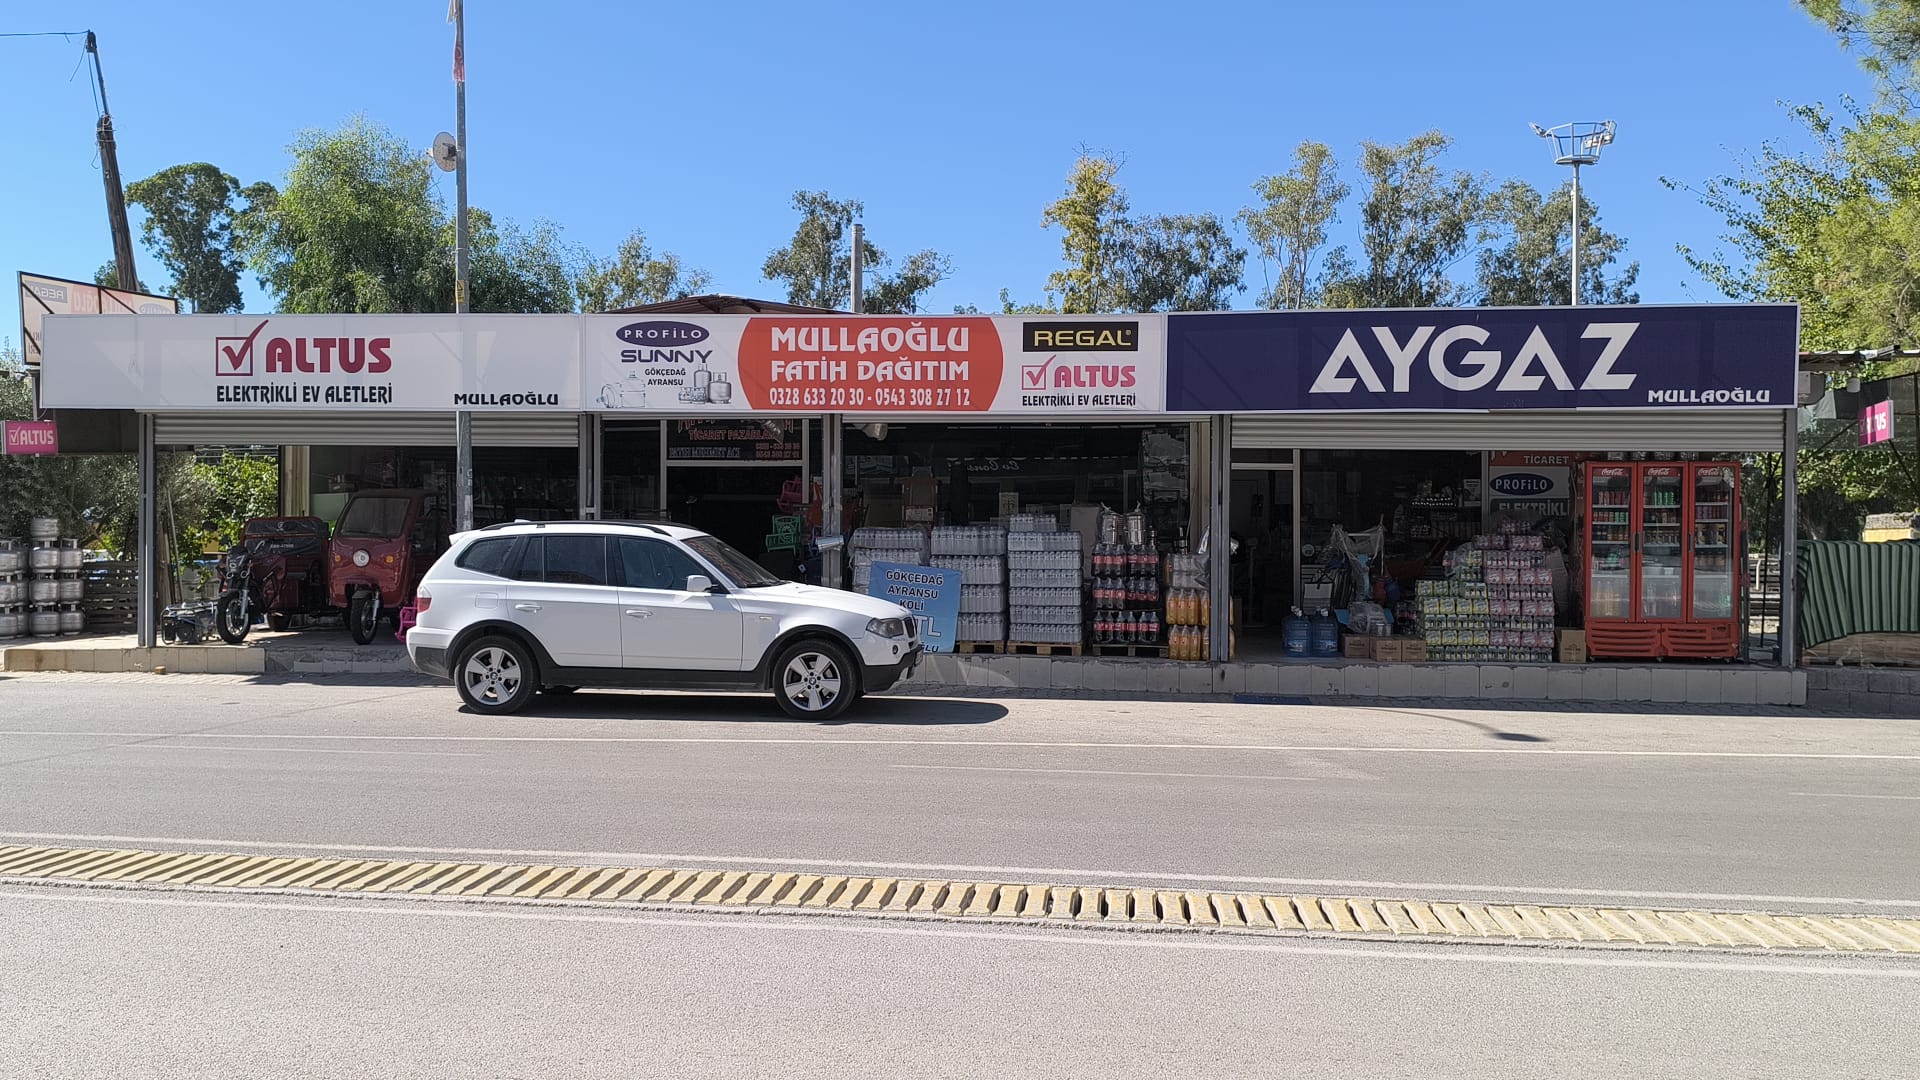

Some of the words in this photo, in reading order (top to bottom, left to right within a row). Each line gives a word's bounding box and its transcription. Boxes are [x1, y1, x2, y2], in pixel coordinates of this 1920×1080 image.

[624, 327, 702, 339] PROFİLO
[771, 321, 969, 354] MULLAOĞLU
[265, 337, 392, 373] ALTUS
[621, 350, 713, 363] SUNNY
[1308, 322, 1641, 393] AYGAZ
[645, 367, 686, 377] GÖKÇEDAĞ
[771, 356, 847, 382] FATİH
[857, 356, 969, 382] DAĞITIM
[1054, 366, 1136, 387] ALTUS
[216, 382, 297, 404] ELEKTRİKLİ
[303, 385, 320, 402] EV
[325, 382, 392, 404] ALETLERİ
[454, 391, 559, 406] MULLAOĞLU
[769, 388, 800, 405] 0328
[804, 388, 826, 405] 633
[830, 388, 845, 405] 20
[849, 388, 864, 405] 30
[875, 388, 905, 405] 0543
[910, 388, 932, 406] 308
[936, 388, 951, 406] 27
[956, 388, 970, 406] 12
[1022, 393, 1075, 407] ELEKTRİKLİ
[1078, 395, 1090, 405] EV
[1092, 393, 1136, 407] ALETLERİ
[1648, 387, 1770, 404] MULLAOĞLU
[20, 430, 54, 445] ALTUS
[1523, 454, 1569, 464] TİCARET
[886, 569, 944, 586] GÖKÇEDAĞ
[888, 585, 938, 599] AYRANSU
[900, 599, 924, 611] KOLİ
